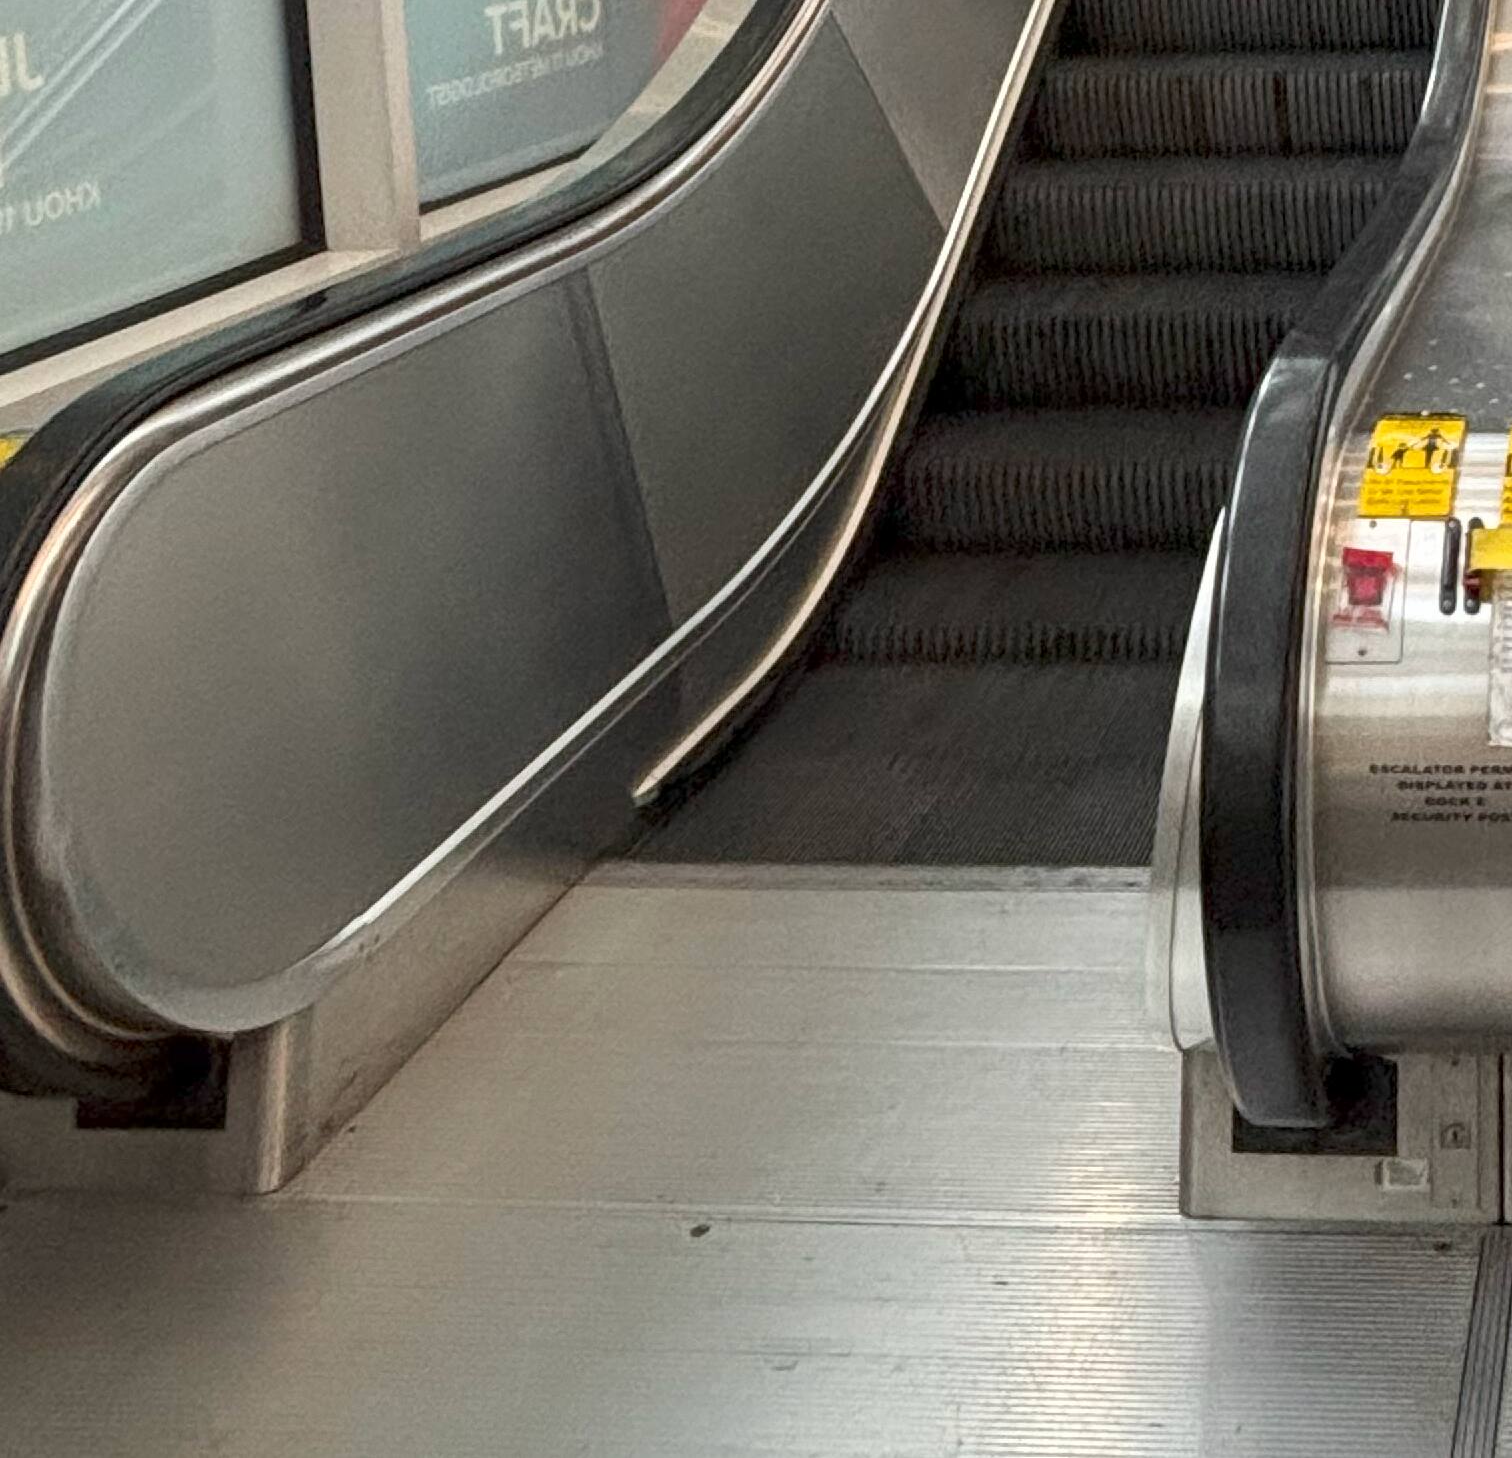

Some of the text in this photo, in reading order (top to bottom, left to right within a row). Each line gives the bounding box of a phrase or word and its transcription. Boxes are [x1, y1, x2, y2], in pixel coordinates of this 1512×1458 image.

[1369, 764, 1465, 775] ESCALATOR
[1397, 780, 1488, 791] DISPLAYED
[1390, 811, 1472, 823] SECURITY
